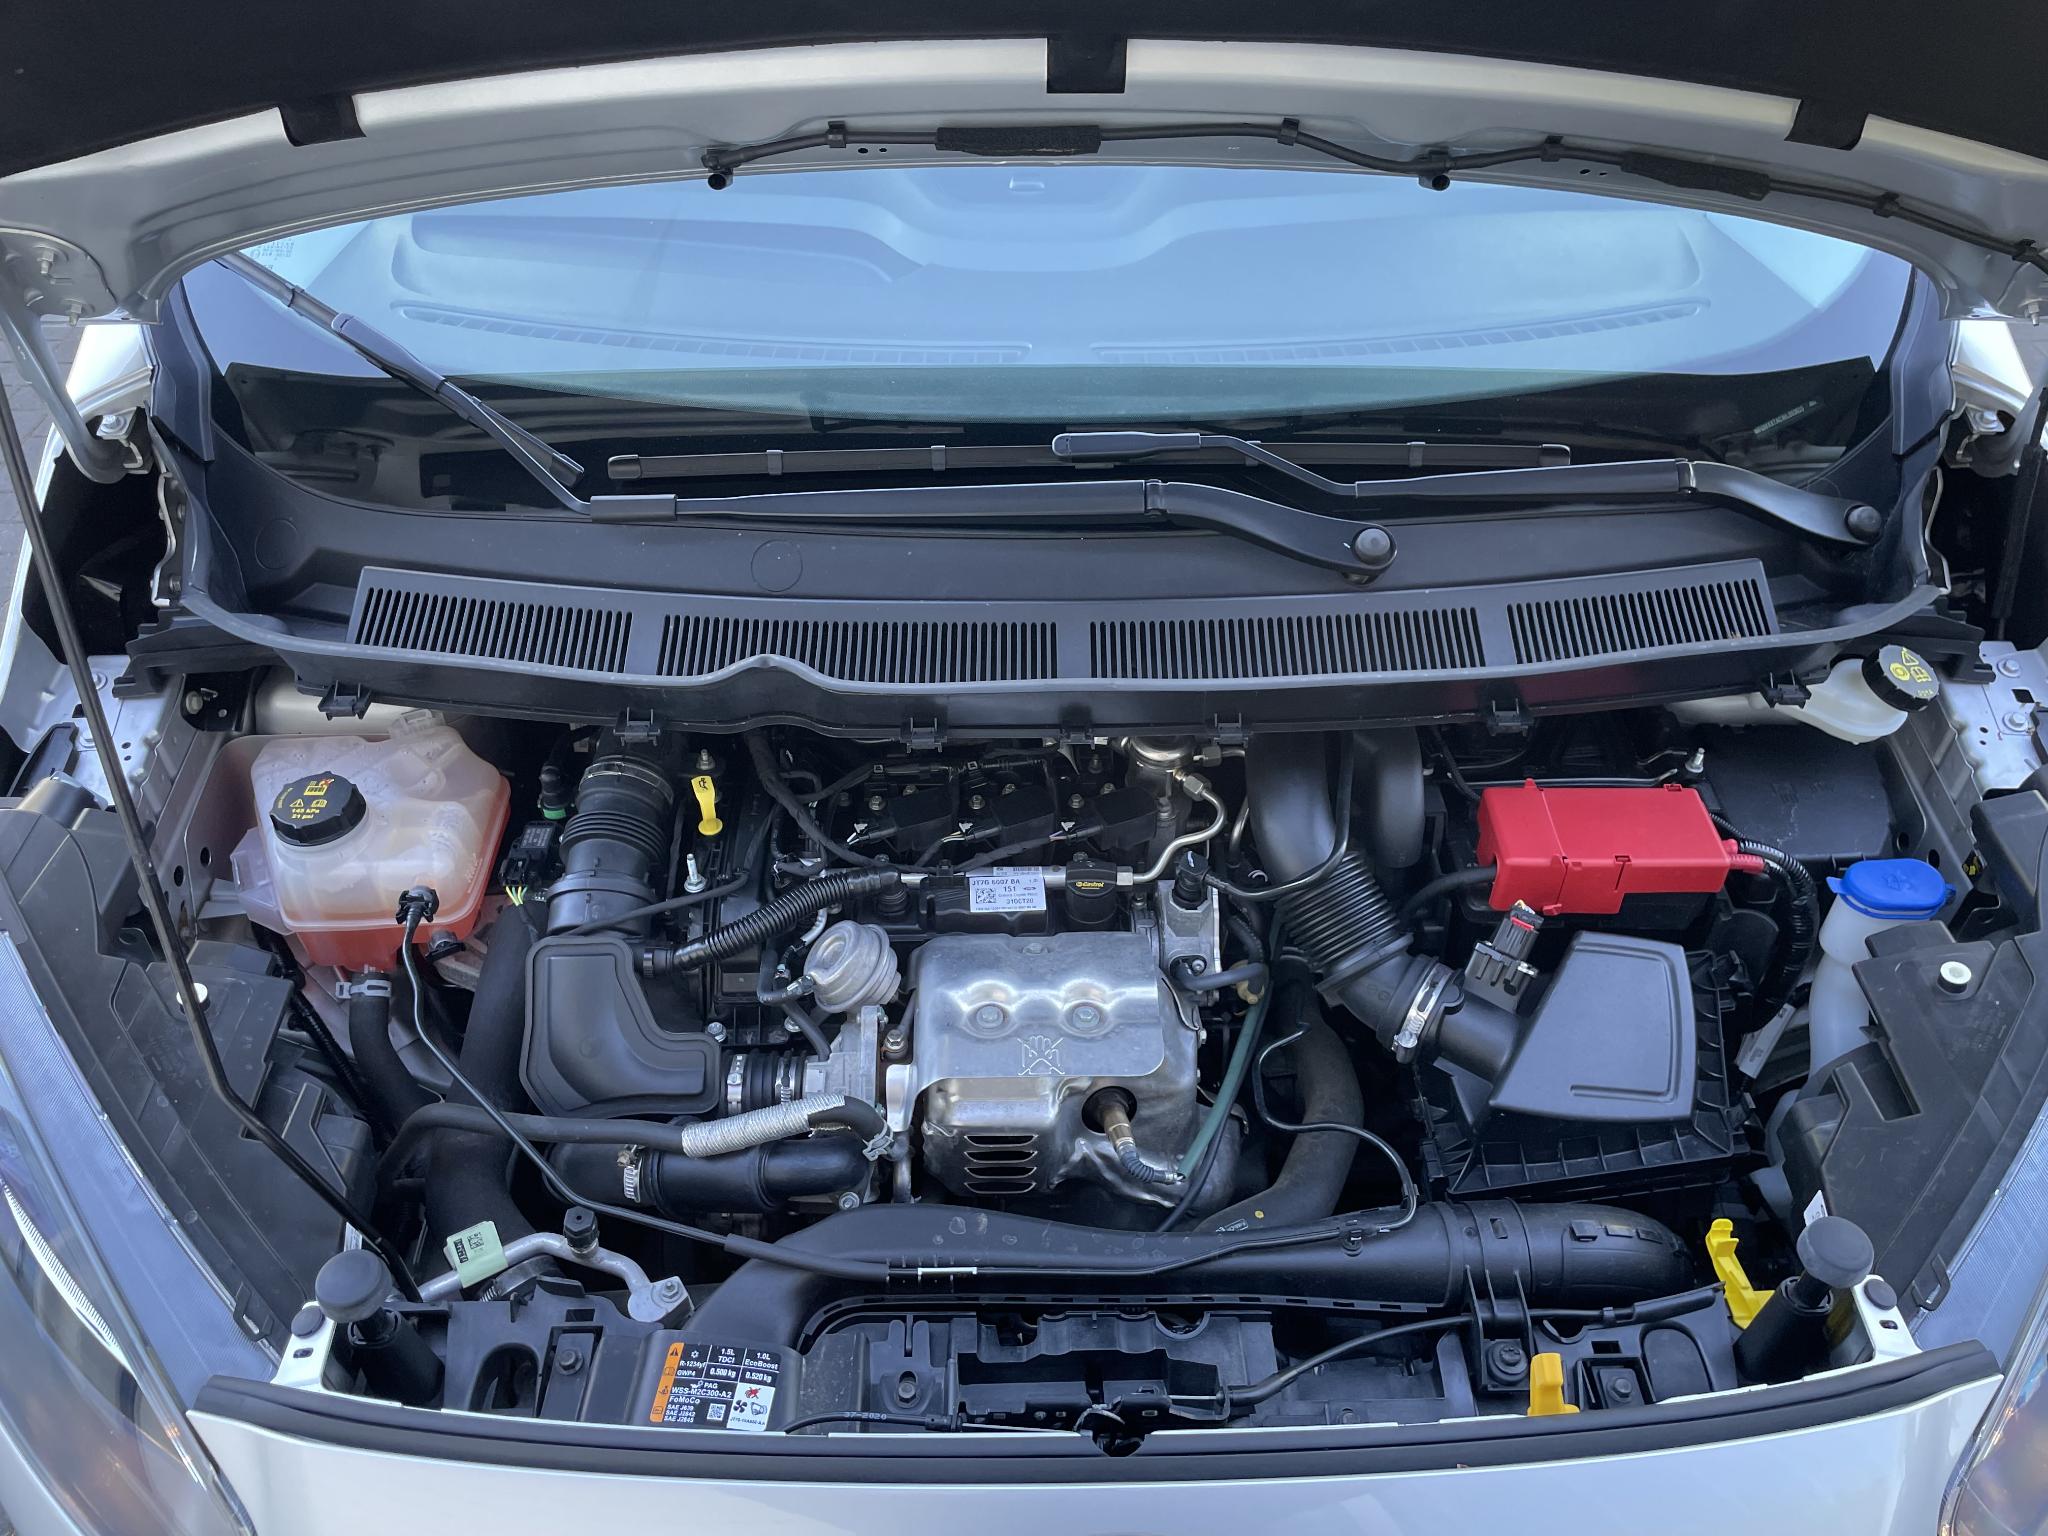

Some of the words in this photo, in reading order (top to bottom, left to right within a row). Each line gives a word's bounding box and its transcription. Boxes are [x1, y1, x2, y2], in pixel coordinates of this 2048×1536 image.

[721, 1348, 735, 1356] 1.5L
[756, 1352, 771, 1360] 1.0L
[744, 1358, 778, 1370] EcoBoost
[728, 1369, 737, 1378] kg
[745, 1371, 763, 1380] 0.520
[763, 1373, 772, 1382] kg
[671, 1386, 732, 1398] WSS-M2C300-A2
[669, 1395, 700, 1404] FoMoCo
